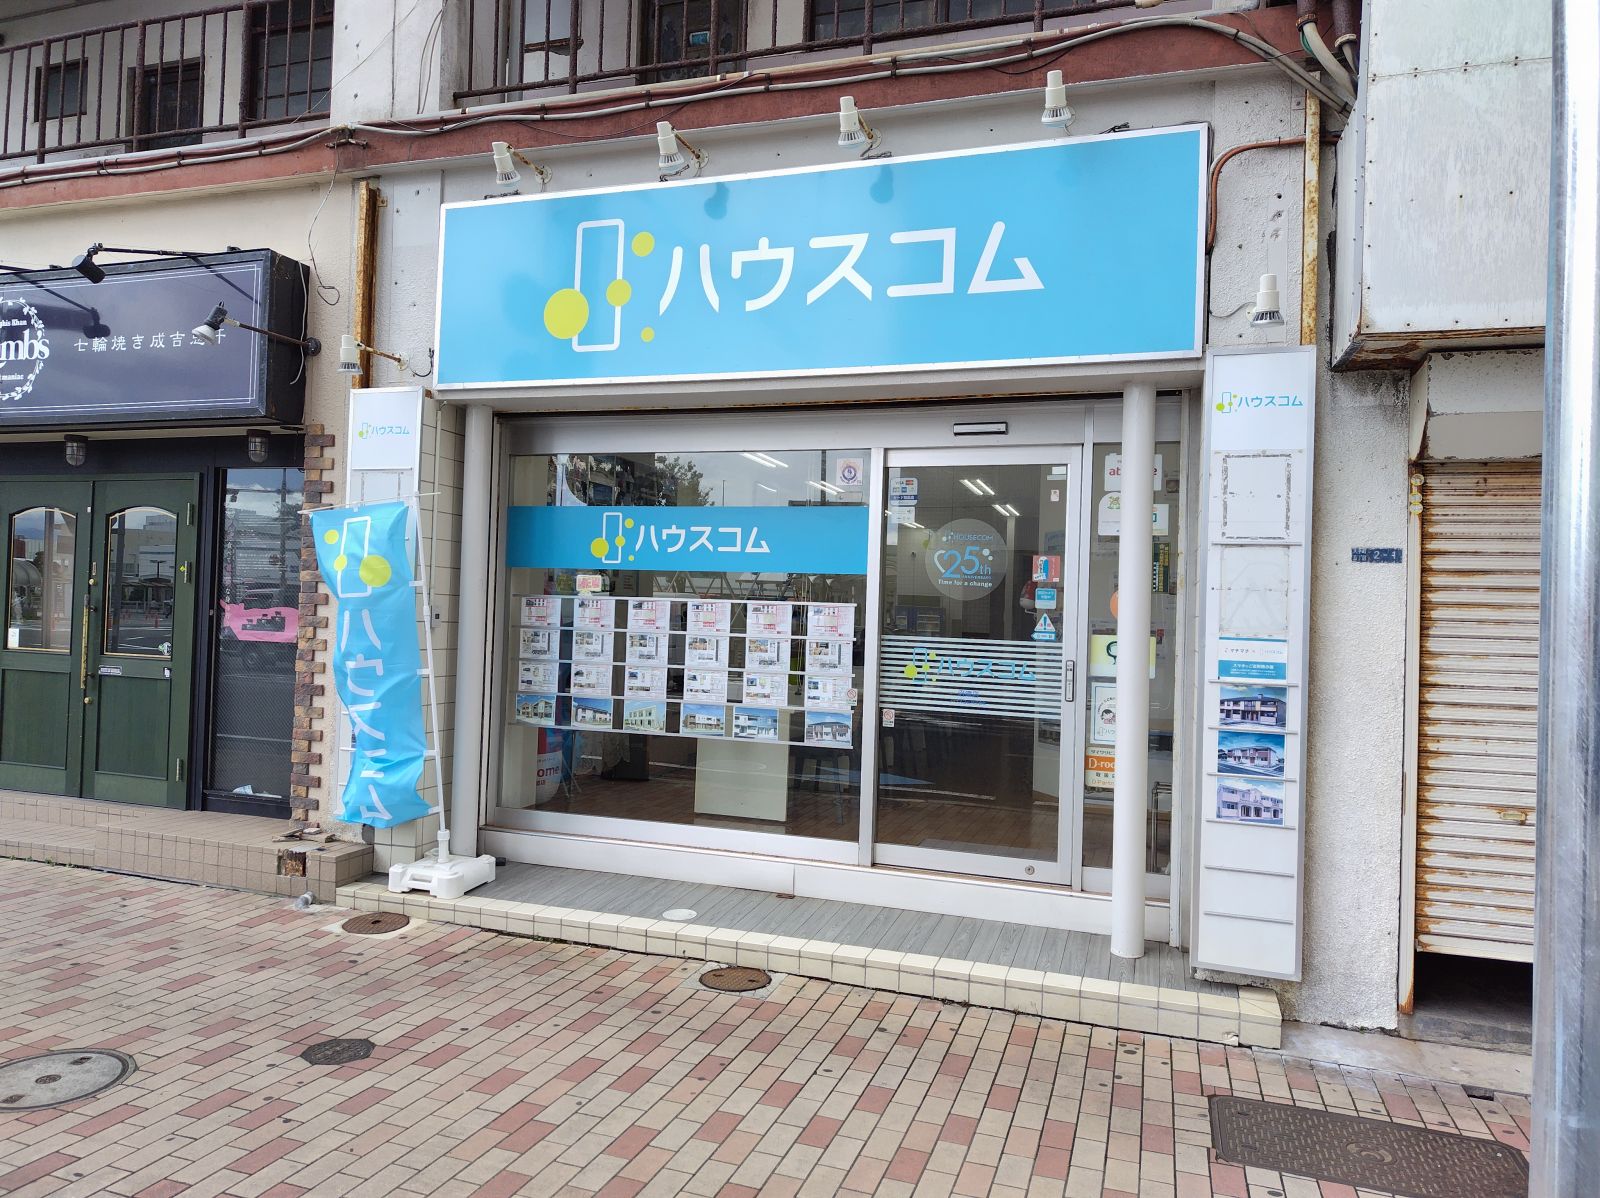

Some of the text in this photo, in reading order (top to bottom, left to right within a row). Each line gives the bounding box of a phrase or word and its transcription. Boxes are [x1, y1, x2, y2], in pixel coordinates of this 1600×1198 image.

[660, 221, 1045, 316] ハウスコム
[0, 328, 50, 361] mb's
[1238, 395, 1304, 408] ハウスコム
[371, 425, 410, 436] ハウスコム
[635, 524, 771, 553] ハウスコム
[970, 580, 993, 588] change
[937, 656, 1036, 681] ハウスコム
